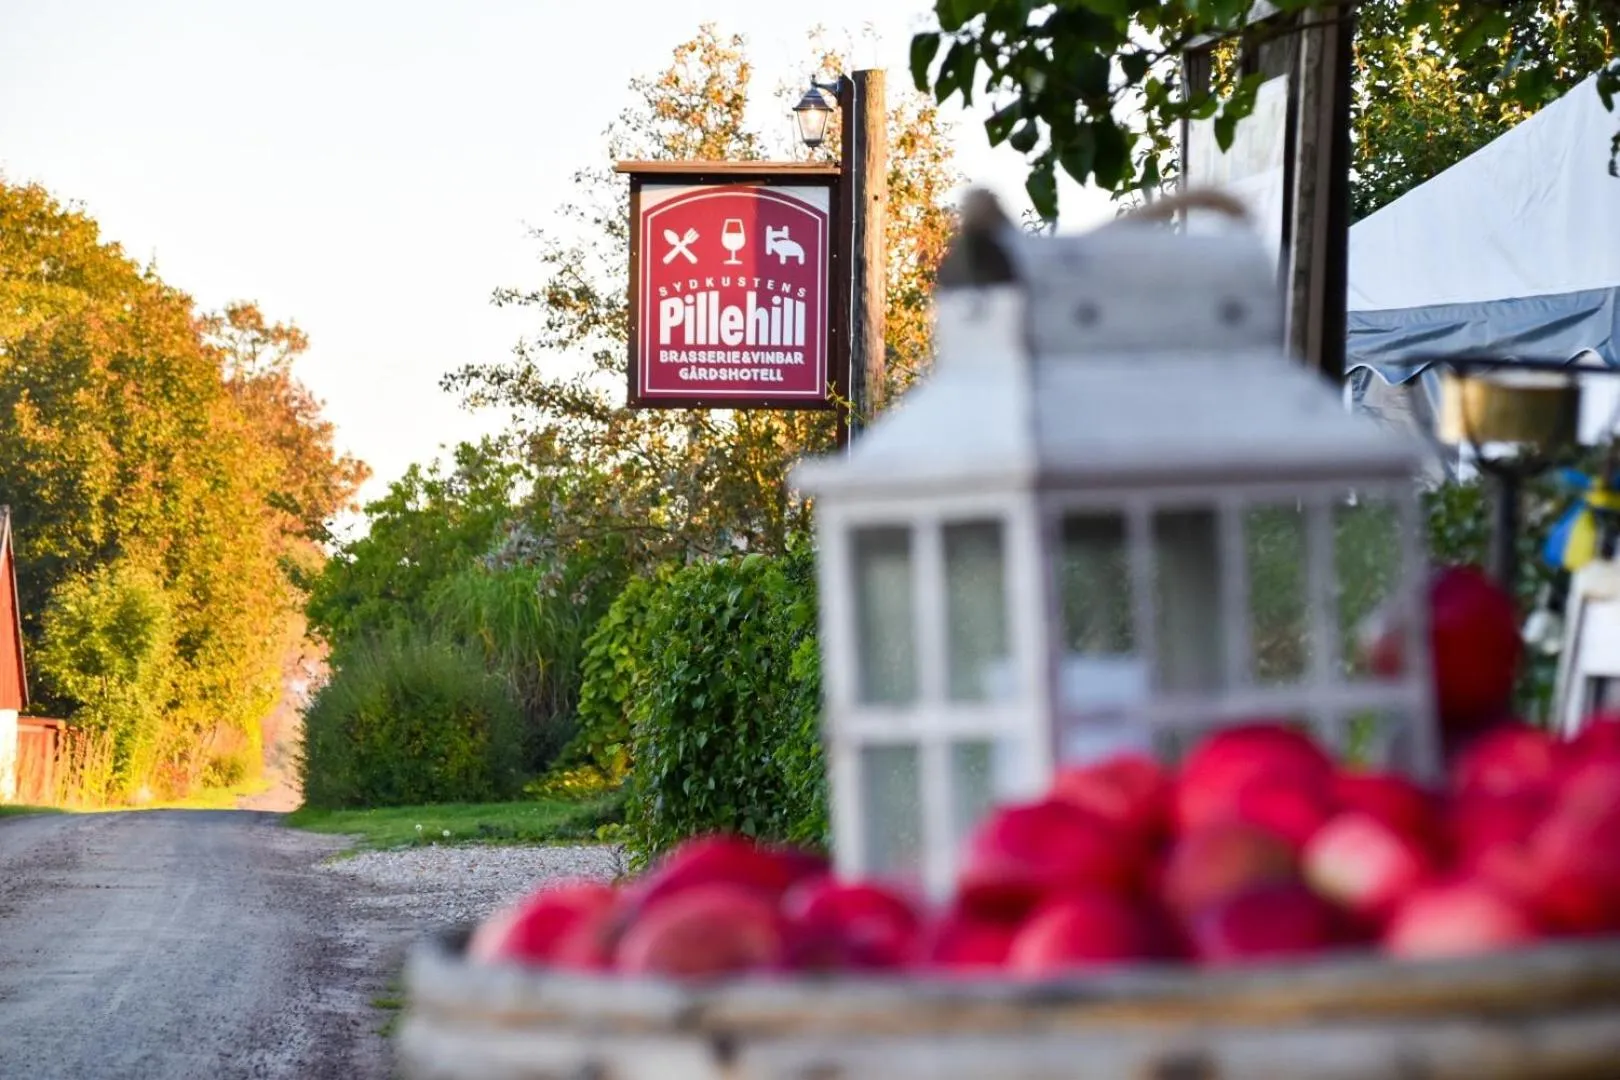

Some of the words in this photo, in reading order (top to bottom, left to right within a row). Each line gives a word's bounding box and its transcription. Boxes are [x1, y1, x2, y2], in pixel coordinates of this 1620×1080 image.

[658, 276, 806, 297] SYDKUSTENS
[659, 290, 806, 347] Pillehill
[679, 367, 784, 382] GÅRDSHOTELL
